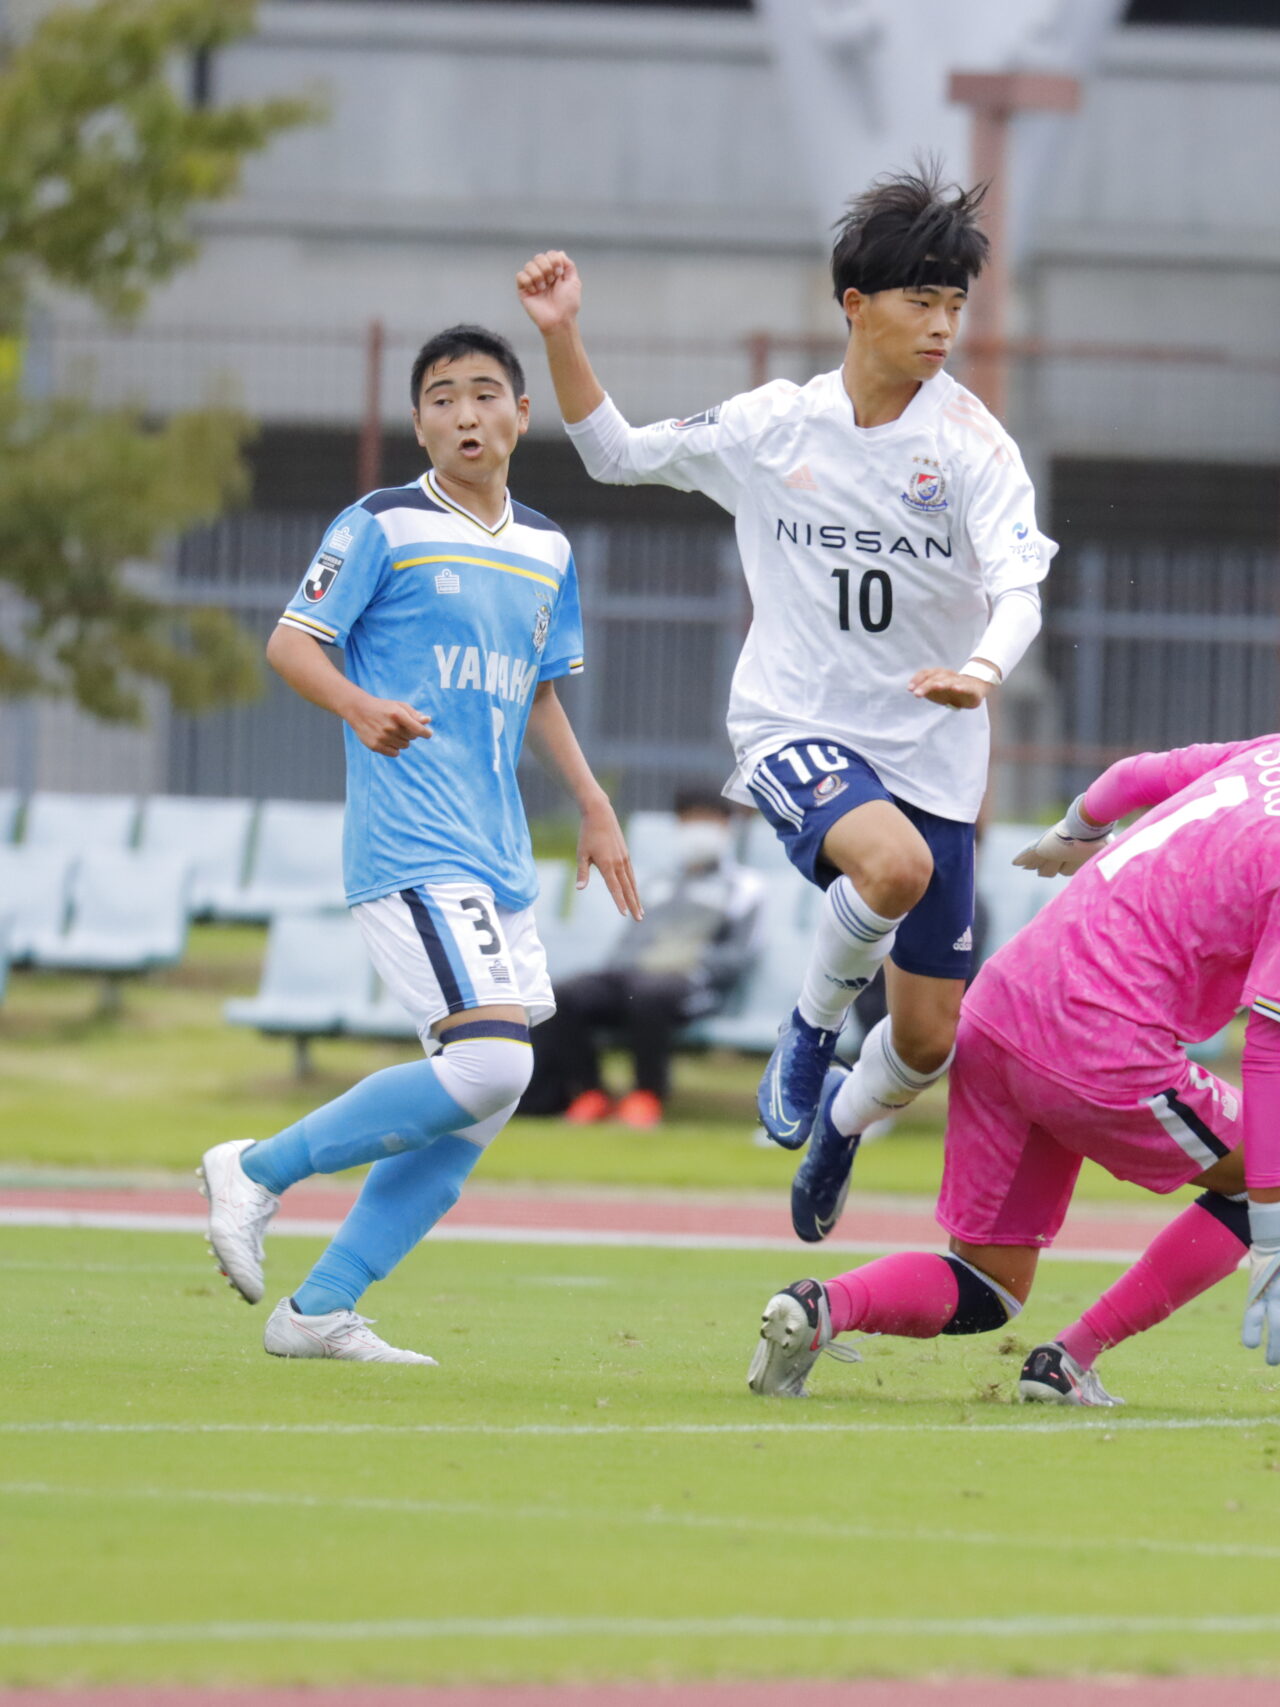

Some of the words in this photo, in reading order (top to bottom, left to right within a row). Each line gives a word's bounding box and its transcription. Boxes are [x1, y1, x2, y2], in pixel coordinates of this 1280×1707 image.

[776, 518, 952, 558] NISSAN
[831, 568, 894, 633] 10
[778, 744, 850, 784] 10
[1095, 775, 1249, 882] 1
[460, 897, 501, 955] 3
